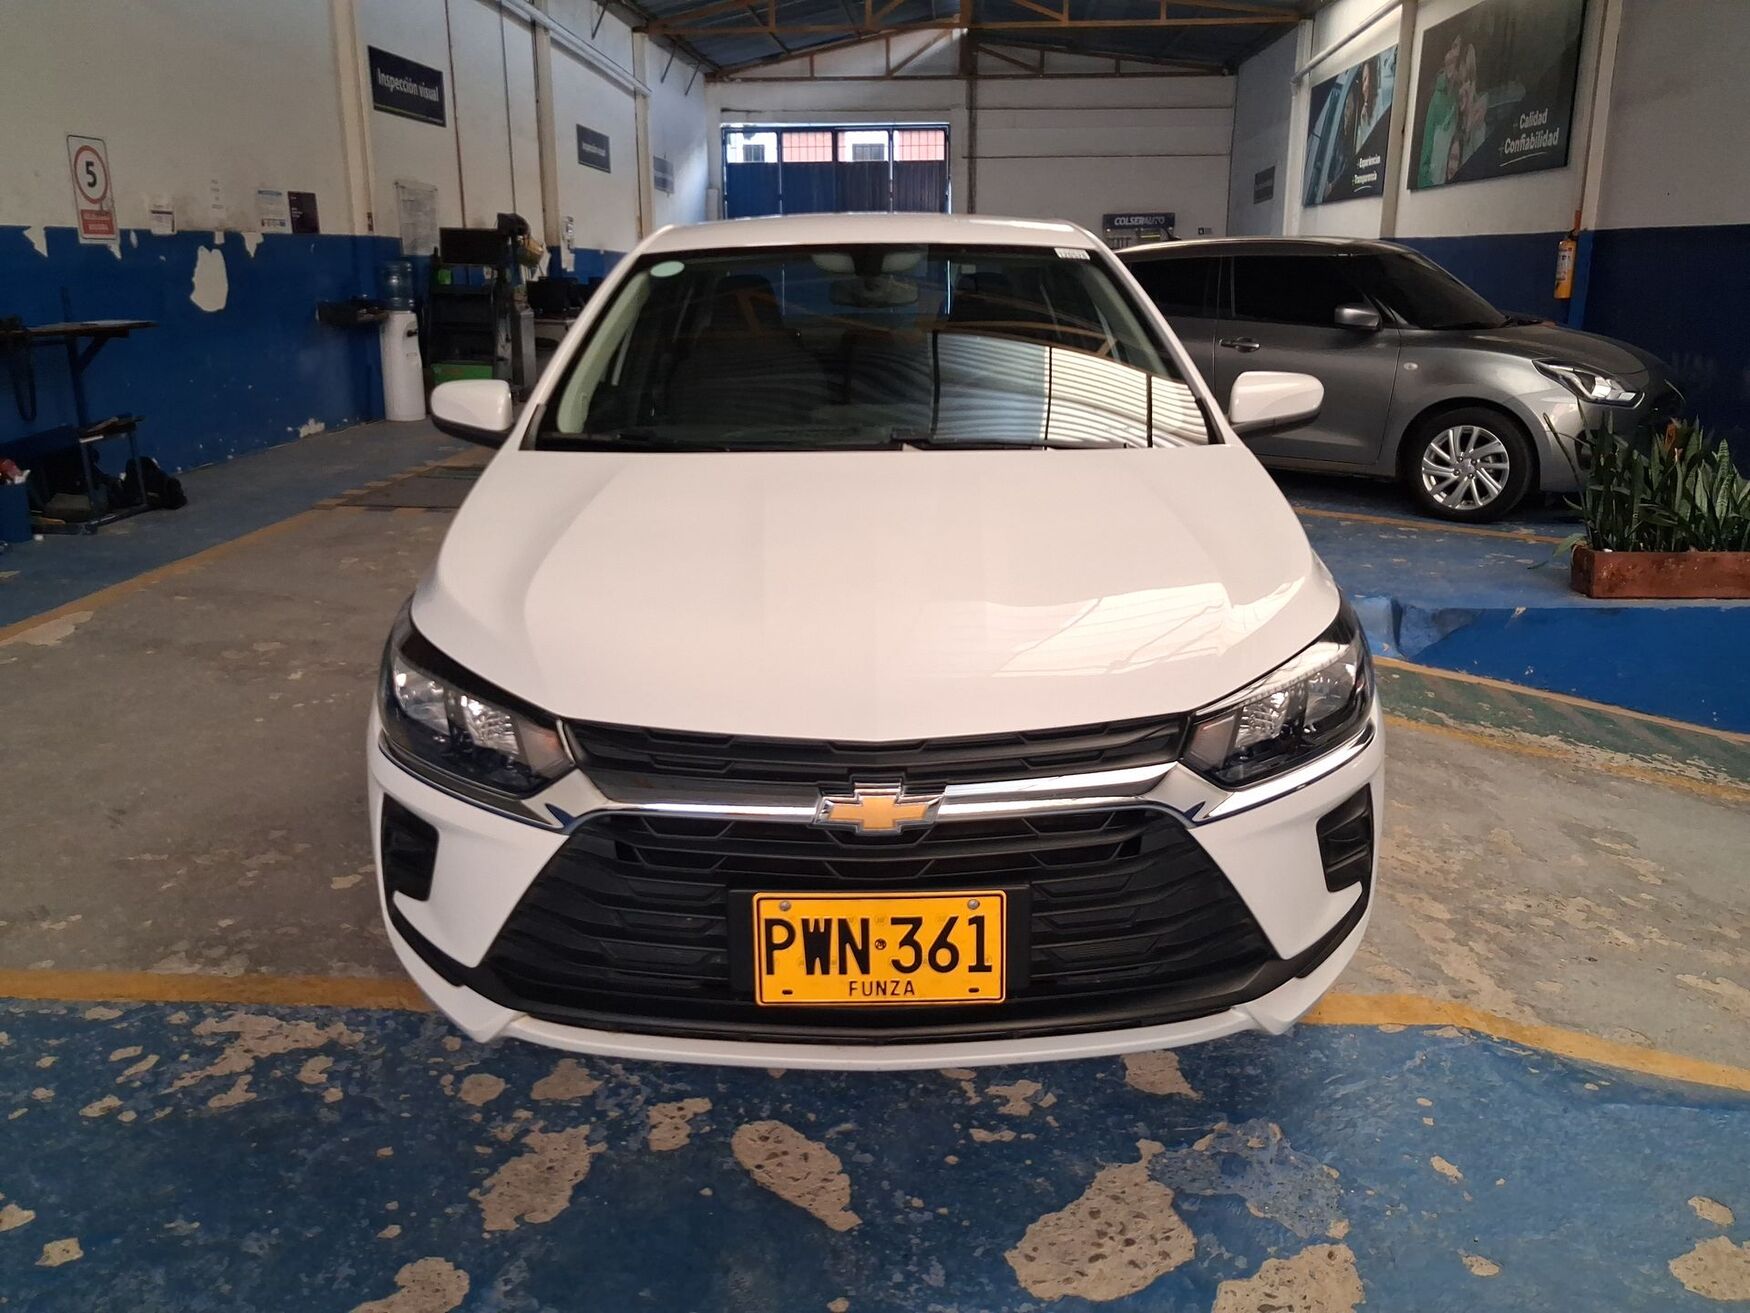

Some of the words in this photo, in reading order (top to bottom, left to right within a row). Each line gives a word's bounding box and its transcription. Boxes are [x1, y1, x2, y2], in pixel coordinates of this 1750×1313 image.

[377, 67, 418, 95] Inspección
[418, 83, 439, 102] visual
[1519, 107, 1549, 129] Calidad
[1504, 127, 1560, 154] Confiabilidad
[85, 160, 97, 188] 5
[764, 917, 870, 976] PWN
[890, 914, 993, 974] 361
[849, 980, 915, 997] FUNZA
